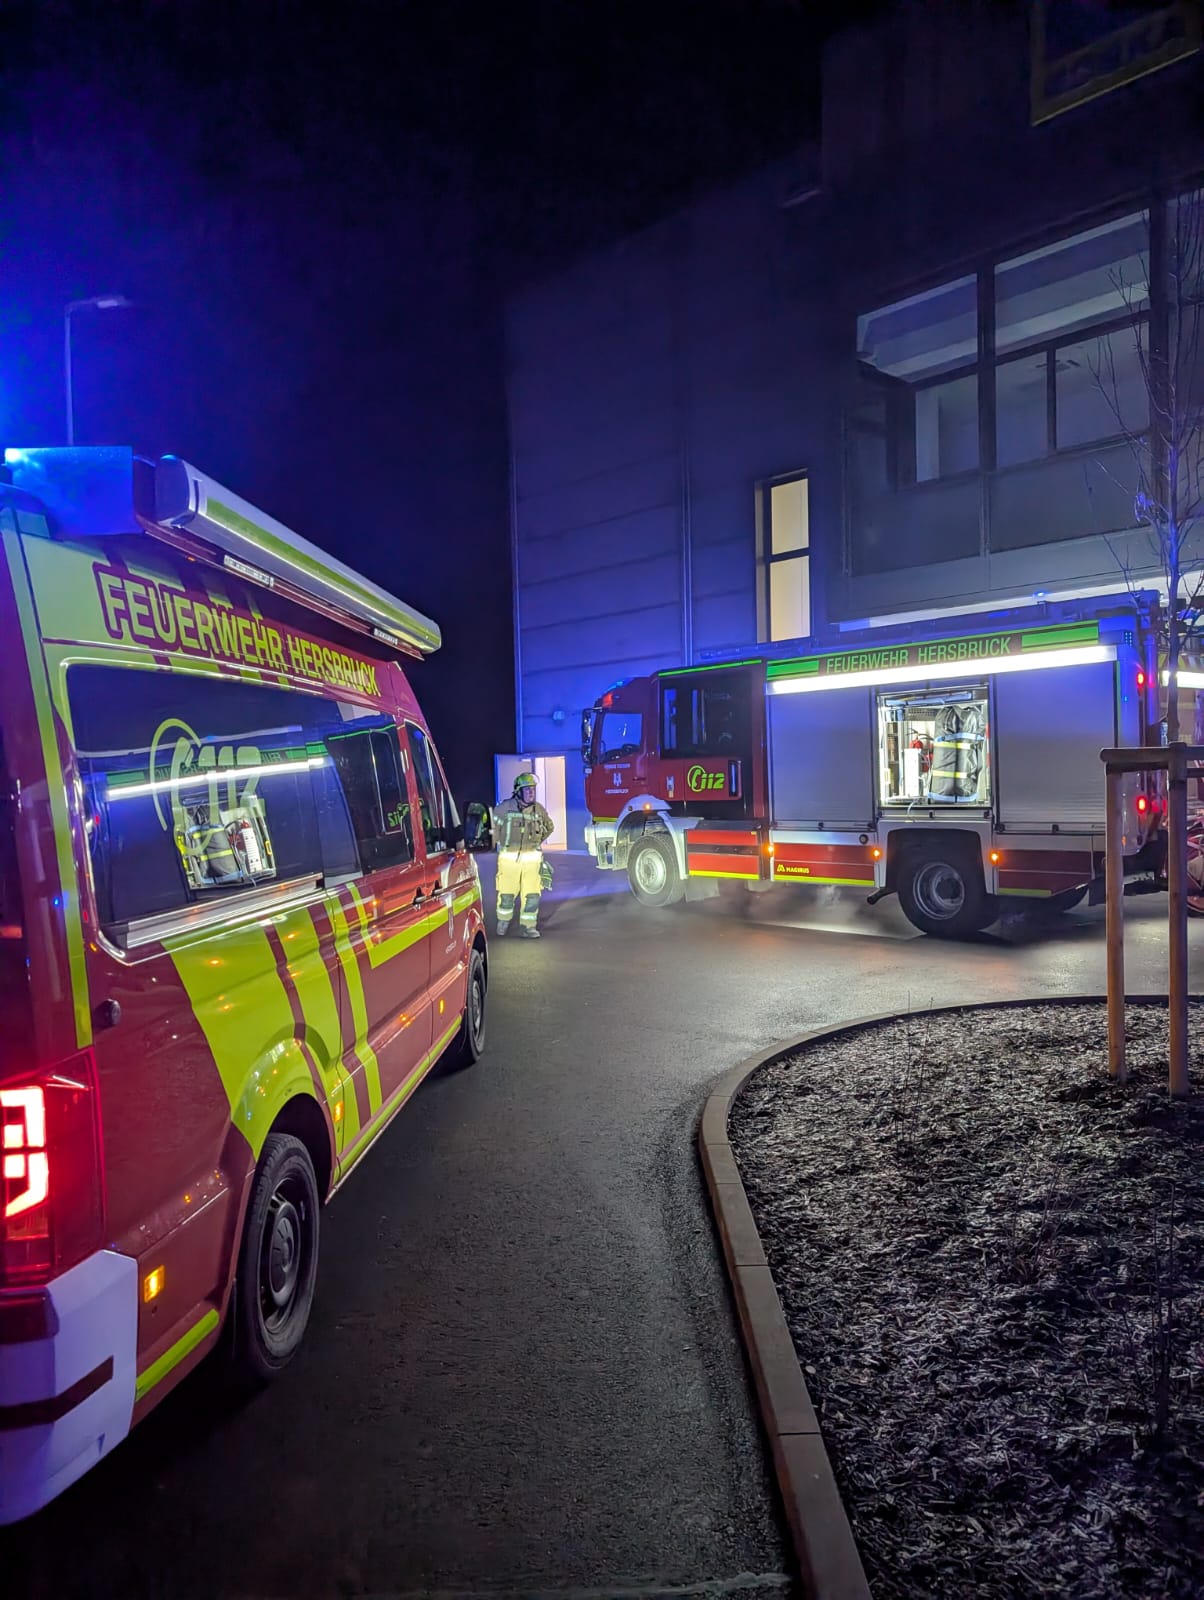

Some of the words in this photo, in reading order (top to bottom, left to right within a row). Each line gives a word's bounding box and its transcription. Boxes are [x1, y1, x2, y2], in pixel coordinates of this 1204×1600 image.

[98, 571, 287, 671] FEUERWEHR
[287, 634, 380, 696] HERSBRUCK
[826, 650, 908, 674] FEUERWEHR
[918, 637, 1011, 663] HERSBRUCK
[700, 772, 725, 789] 112
